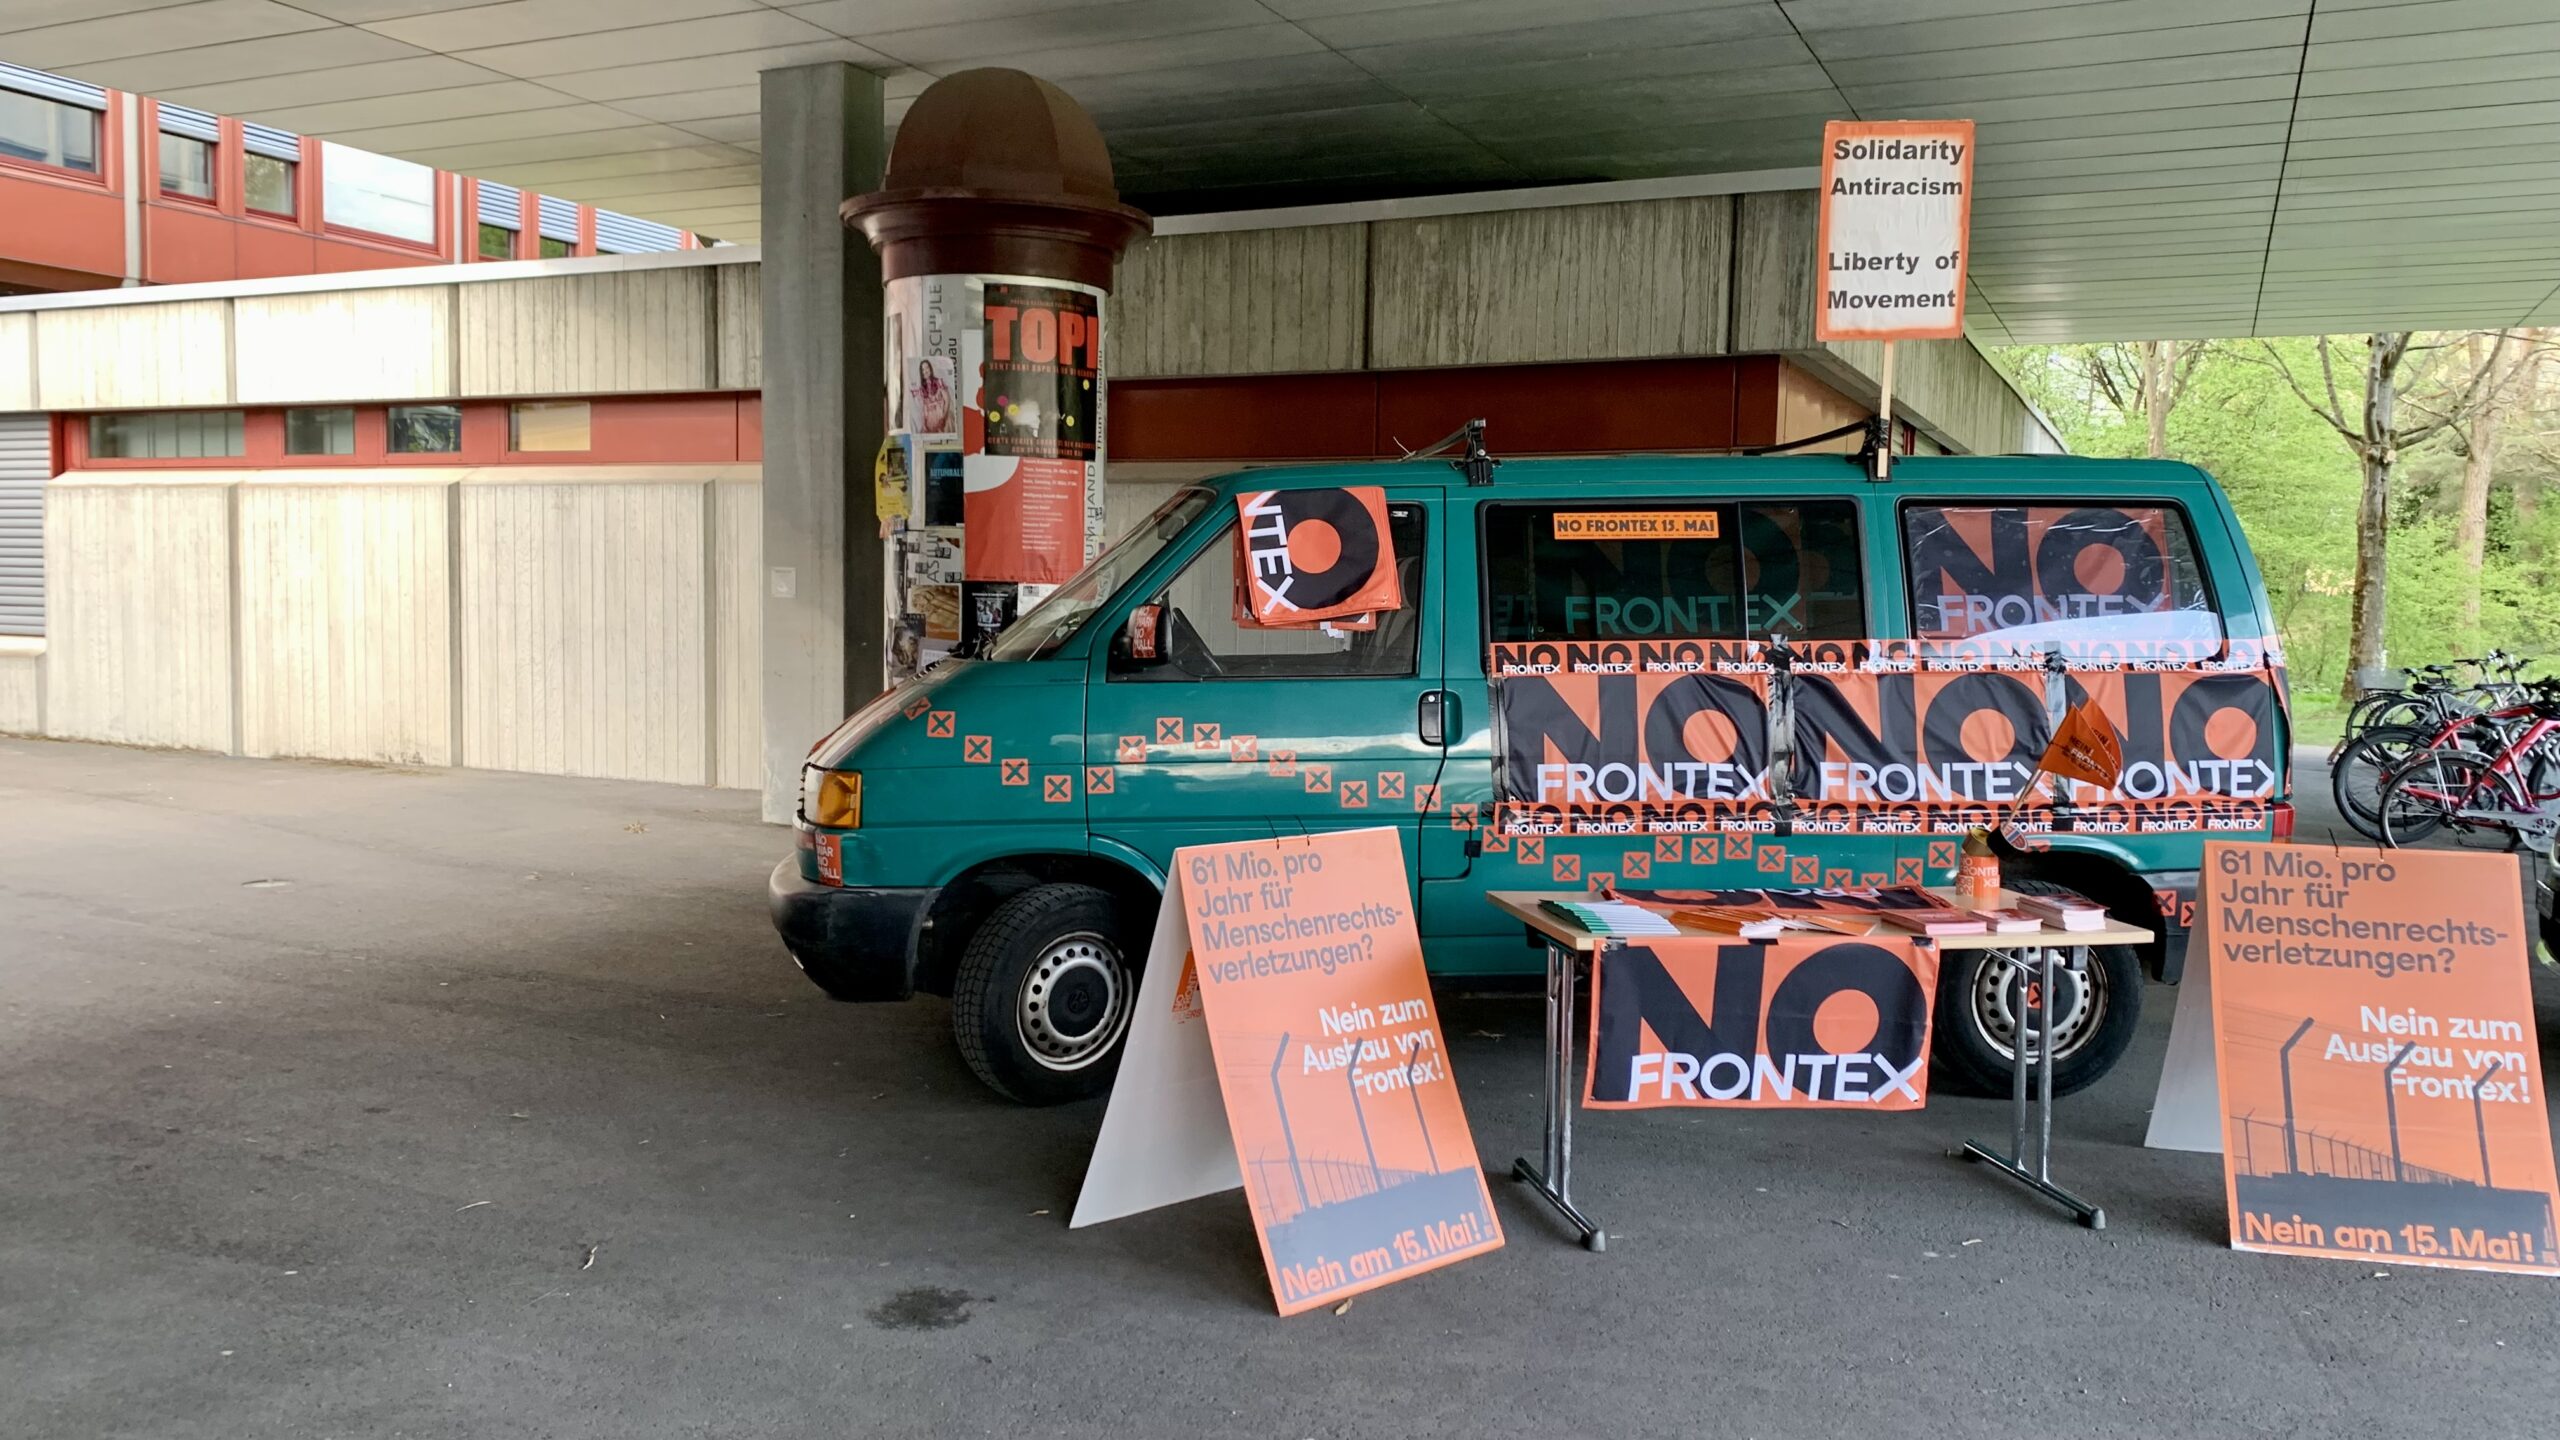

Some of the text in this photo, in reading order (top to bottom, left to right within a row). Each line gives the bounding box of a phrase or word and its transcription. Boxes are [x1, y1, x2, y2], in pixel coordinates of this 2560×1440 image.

[1834, 139, 1965, 165] Solidarity
[1831, 177, 1962, 196] Antiracism
[1829, 250, 1960, 275] Liberty of
[1827, 289, 1956, 309] Movement
[1557, 519, 1715, 532] NO FRONTEX 15. MAI
[1908, 508, 2166, 633] NO
[1565, 594, 1802, 635] FRONTEX
[1495, 643, 1560, 673] NO
[1567, 643, 1632, 673] NO
[1639, 642, 1704, 672] NO
[1502, 664, 1562, 675] FRONTEX
[1574, 663, 1634, 674] FRONTEX
[1646, 662, 1706, 674] FRONTEX
[1716, 662, 1775, 673] FRONTEX
[1790, 662, 1848, 673] FRONTEX
[1859, 661, 1917, 673] FRONTEX
[1928, 661, 1986, 672] FRONTEX
[2065, 661, 2124, 672] FRONTEX
[2133, 661, 2191, 672] FRONTEX
[1505, 673, 1770, 802] NO
[1792, 672, 2050, 802] NO
[1536, 760, 1770, 803] FRONTEX
[1819, 760, 2055, 802] FRONTEX
[1504, 823, 1564, 835] FRONTEX
[1577, 822, 1636, 833] FRONTEX
[1649, 821, 1708, 833] FRONTEX
[1792, 821, 1850, 833] FRONTEX
[1862, 821, 1921, 833] FRONTEX
[2073, 821, 2129, 832] FRONTEX
[2142, 819, 2197, 831] FRONTEX
[2208, 818, 2262, 830] FRONTEX
[1570, 803, 1635, 833] NO
[1642, 802, 1707, 833] NO
[1714, 801, 1777, 832] NO
[1928, 803, 1989, 832] NO
[2136, 801, 2196, 831] NO
[2202, 800, 2263, 830] NO
[1191, 852, 1323, 885] 61 Mio. pro
[2219, 849, 2396, 887] 61 Mio. pro
[1197, 882, 1294, 919] Jahr für
[2220, 879, 2350, 910] Jahr für
[1201, 901, 1403, 952] Menschenrechts-
[2223, 907, 2508, 946] Menschenrechts-
[1208, 933, 1375, 984] verletzungen?
[2223, 941, 2456, 979] verletzungen?
[1319, 998, 1428, 1037] Nein zum
[1592, 942, 1928, 1102] NO
[2360, 1005, 2523, 1042] Nein zum
[1303, 1027, 1436, 1075] Ausbau von
[2324, 1033, 2527, 1073] Ausbau von
[1352, 1051, 1445, 1096] Frontex!
[1628, 1052, 1924, 1103] FRONTEX
[2390, 1067, 2531, 1104] Frontex!
[2244, 1212, 2326, 1247] Nein
[2333, 1225, 2393, 1252] am
[1281, 1255, 1347, 1300] Nein
[1351, 1244, 1392, 1277] am
